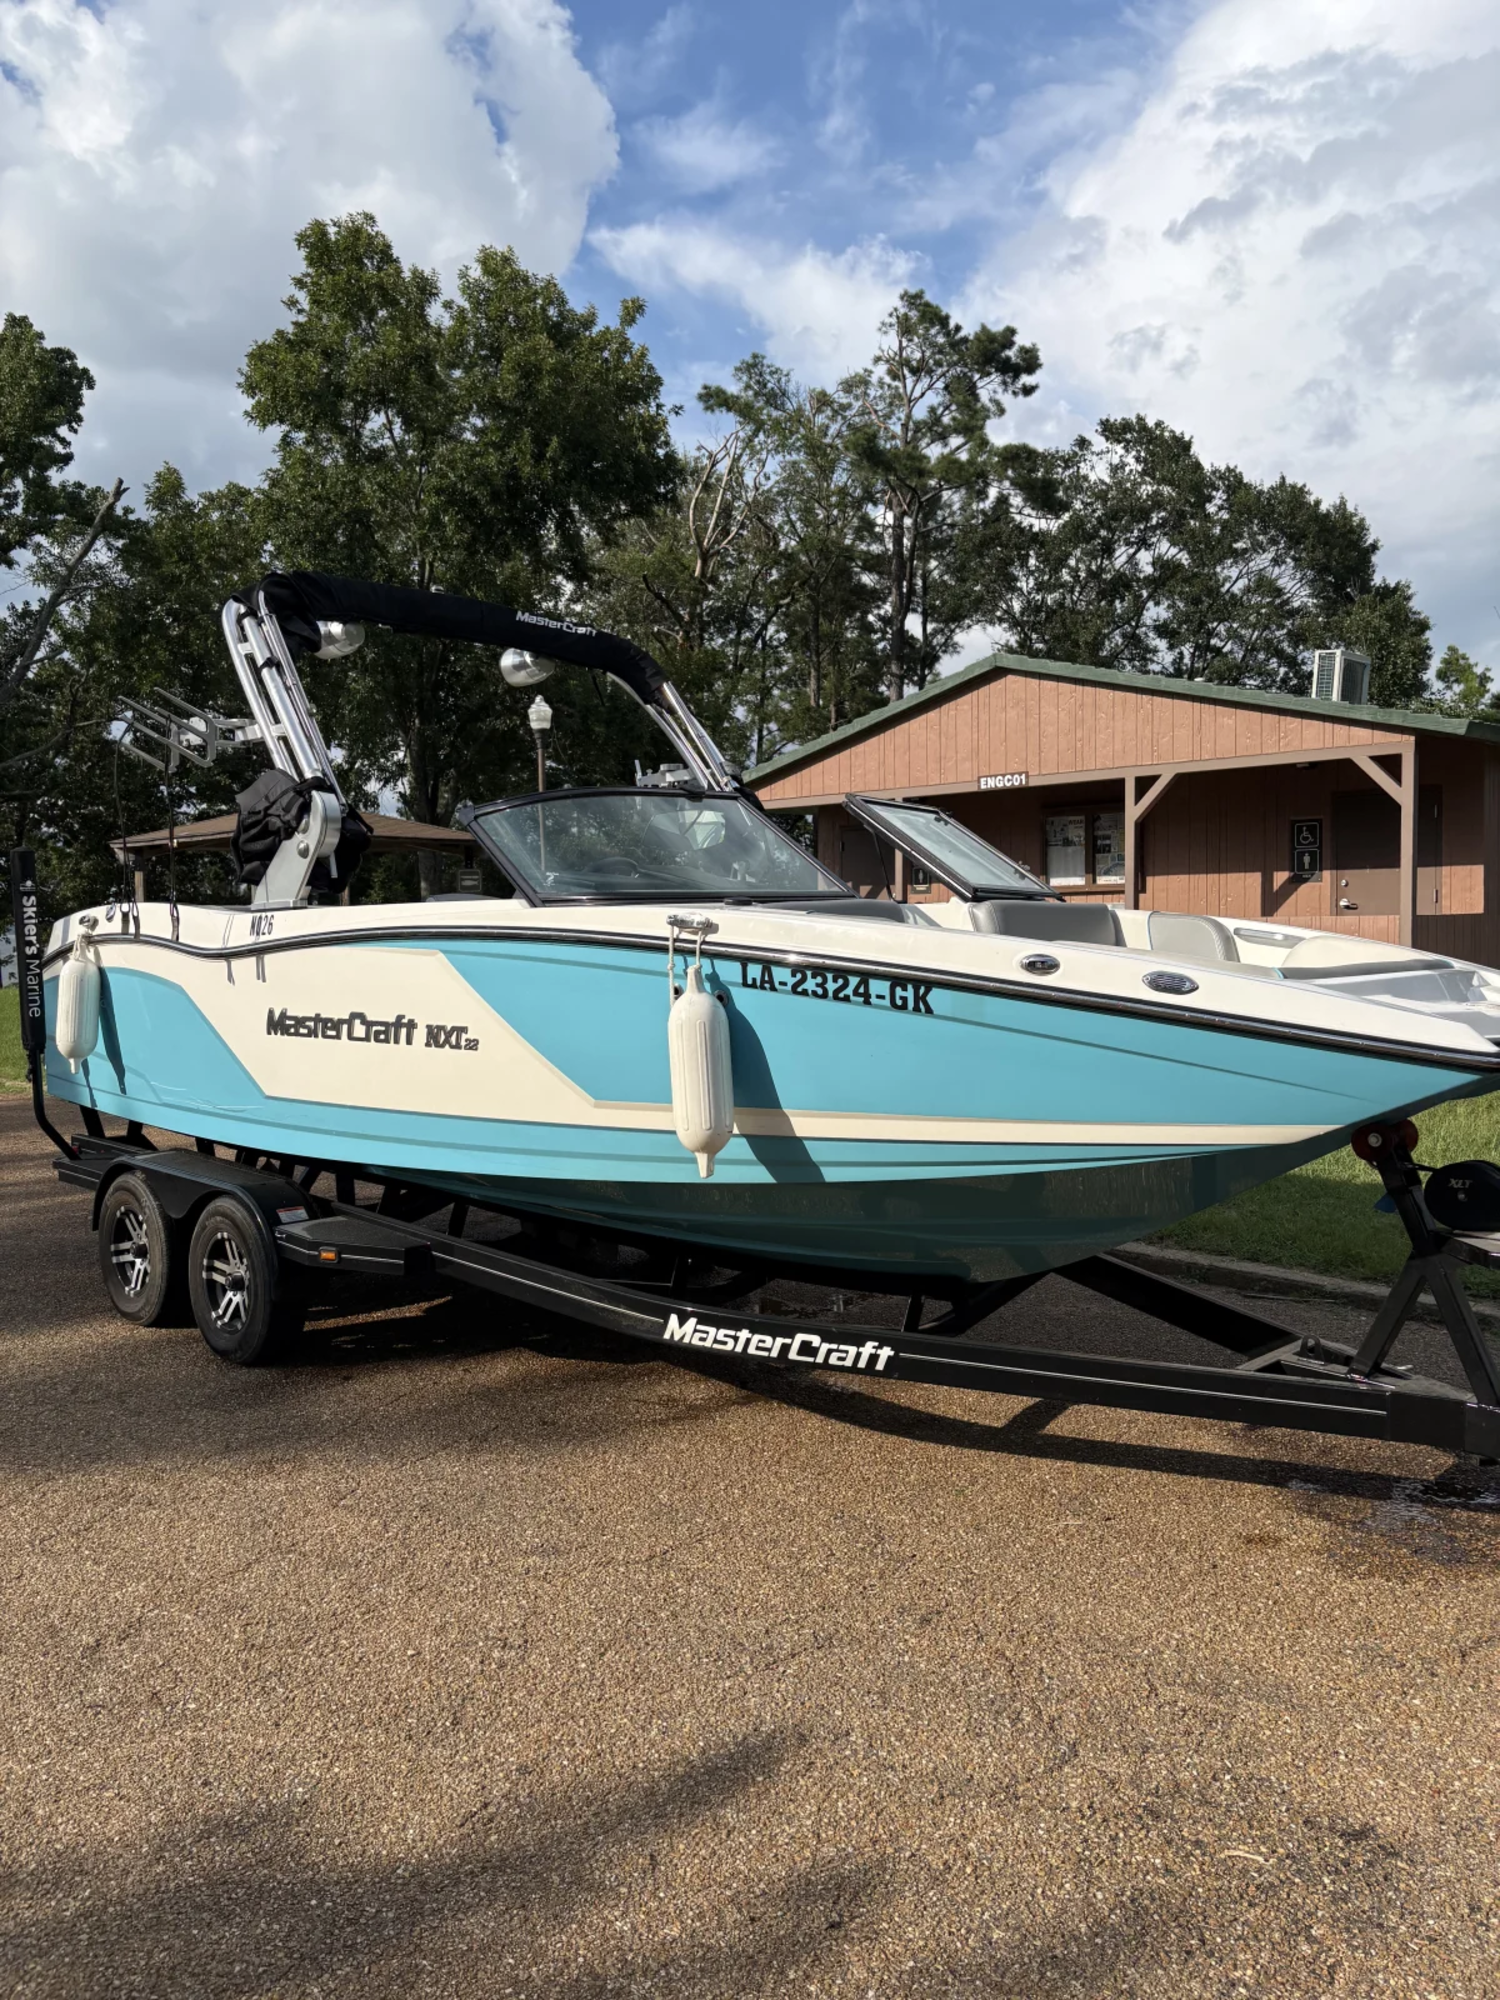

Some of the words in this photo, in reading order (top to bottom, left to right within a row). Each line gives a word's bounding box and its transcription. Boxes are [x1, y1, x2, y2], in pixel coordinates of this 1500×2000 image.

[515, 610, 597, 637] MasterCraft
[980, 773, 1026, 789] ENGC01
[22, 895, 40, 955] Skier's
[25, 959, 43, 1018] Marine
[740, 962, 934, 1015] LA-2324-GK
[266, 1007, 418, 1045] MasterCraft
[1447, 1178, 1473, 1189] XLT
[662, 1313, 894, 1371] MasterCraft
